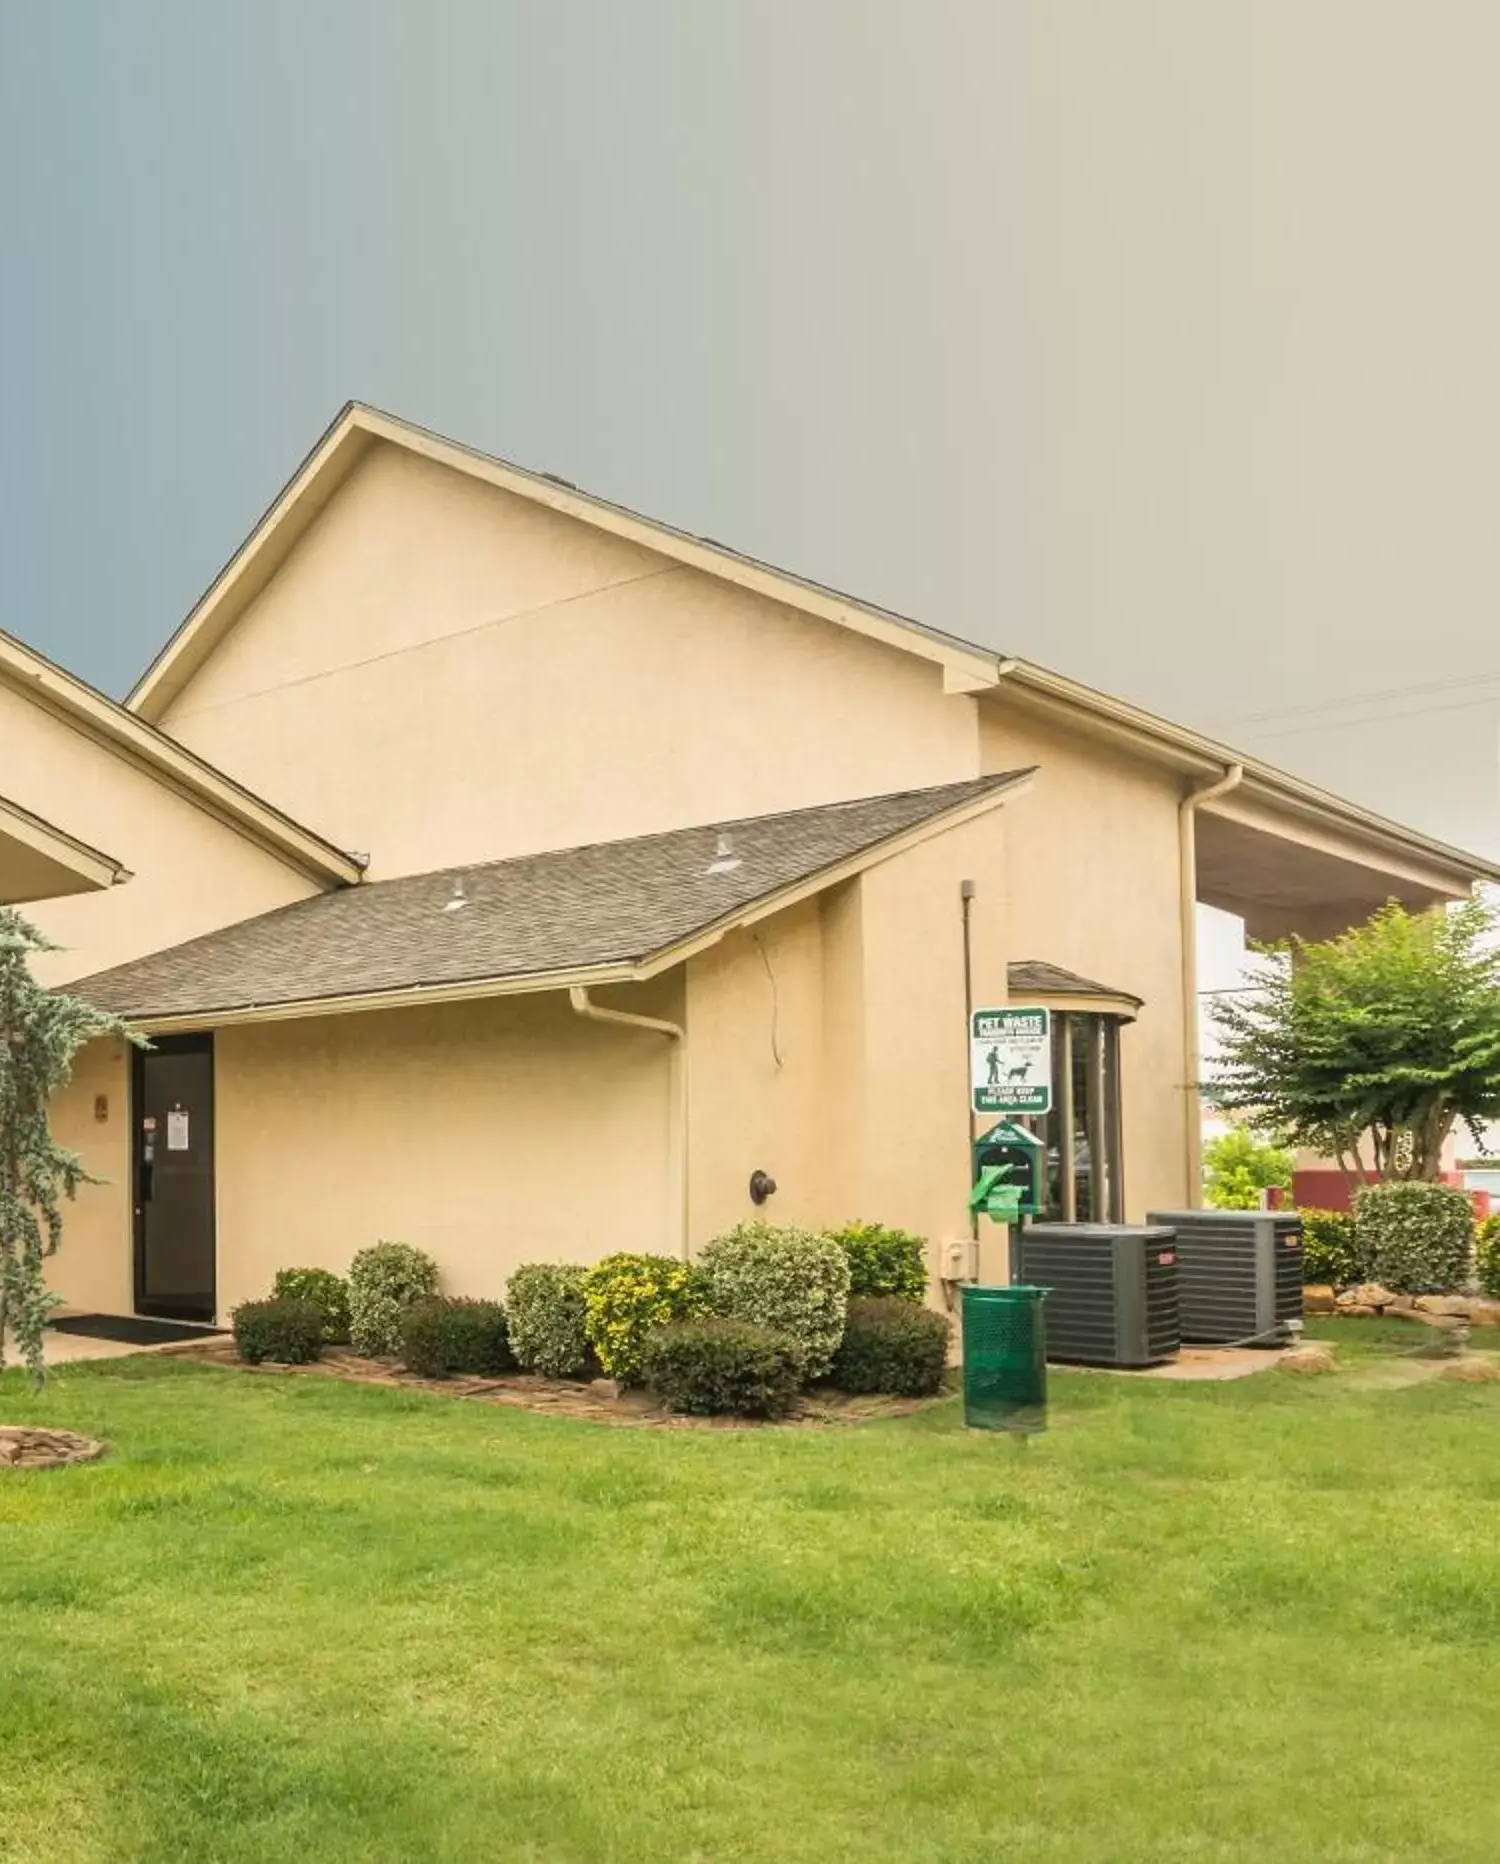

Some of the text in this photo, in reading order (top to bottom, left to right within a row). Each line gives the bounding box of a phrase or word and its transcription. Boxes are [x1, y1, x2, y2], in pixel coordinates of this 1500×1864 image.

[979, 1016, 1042, 1029] PET WASTE
[999, 1096, 1018, 1104] AREA
[1019, 1095, 1043, 1104] CLEAN
